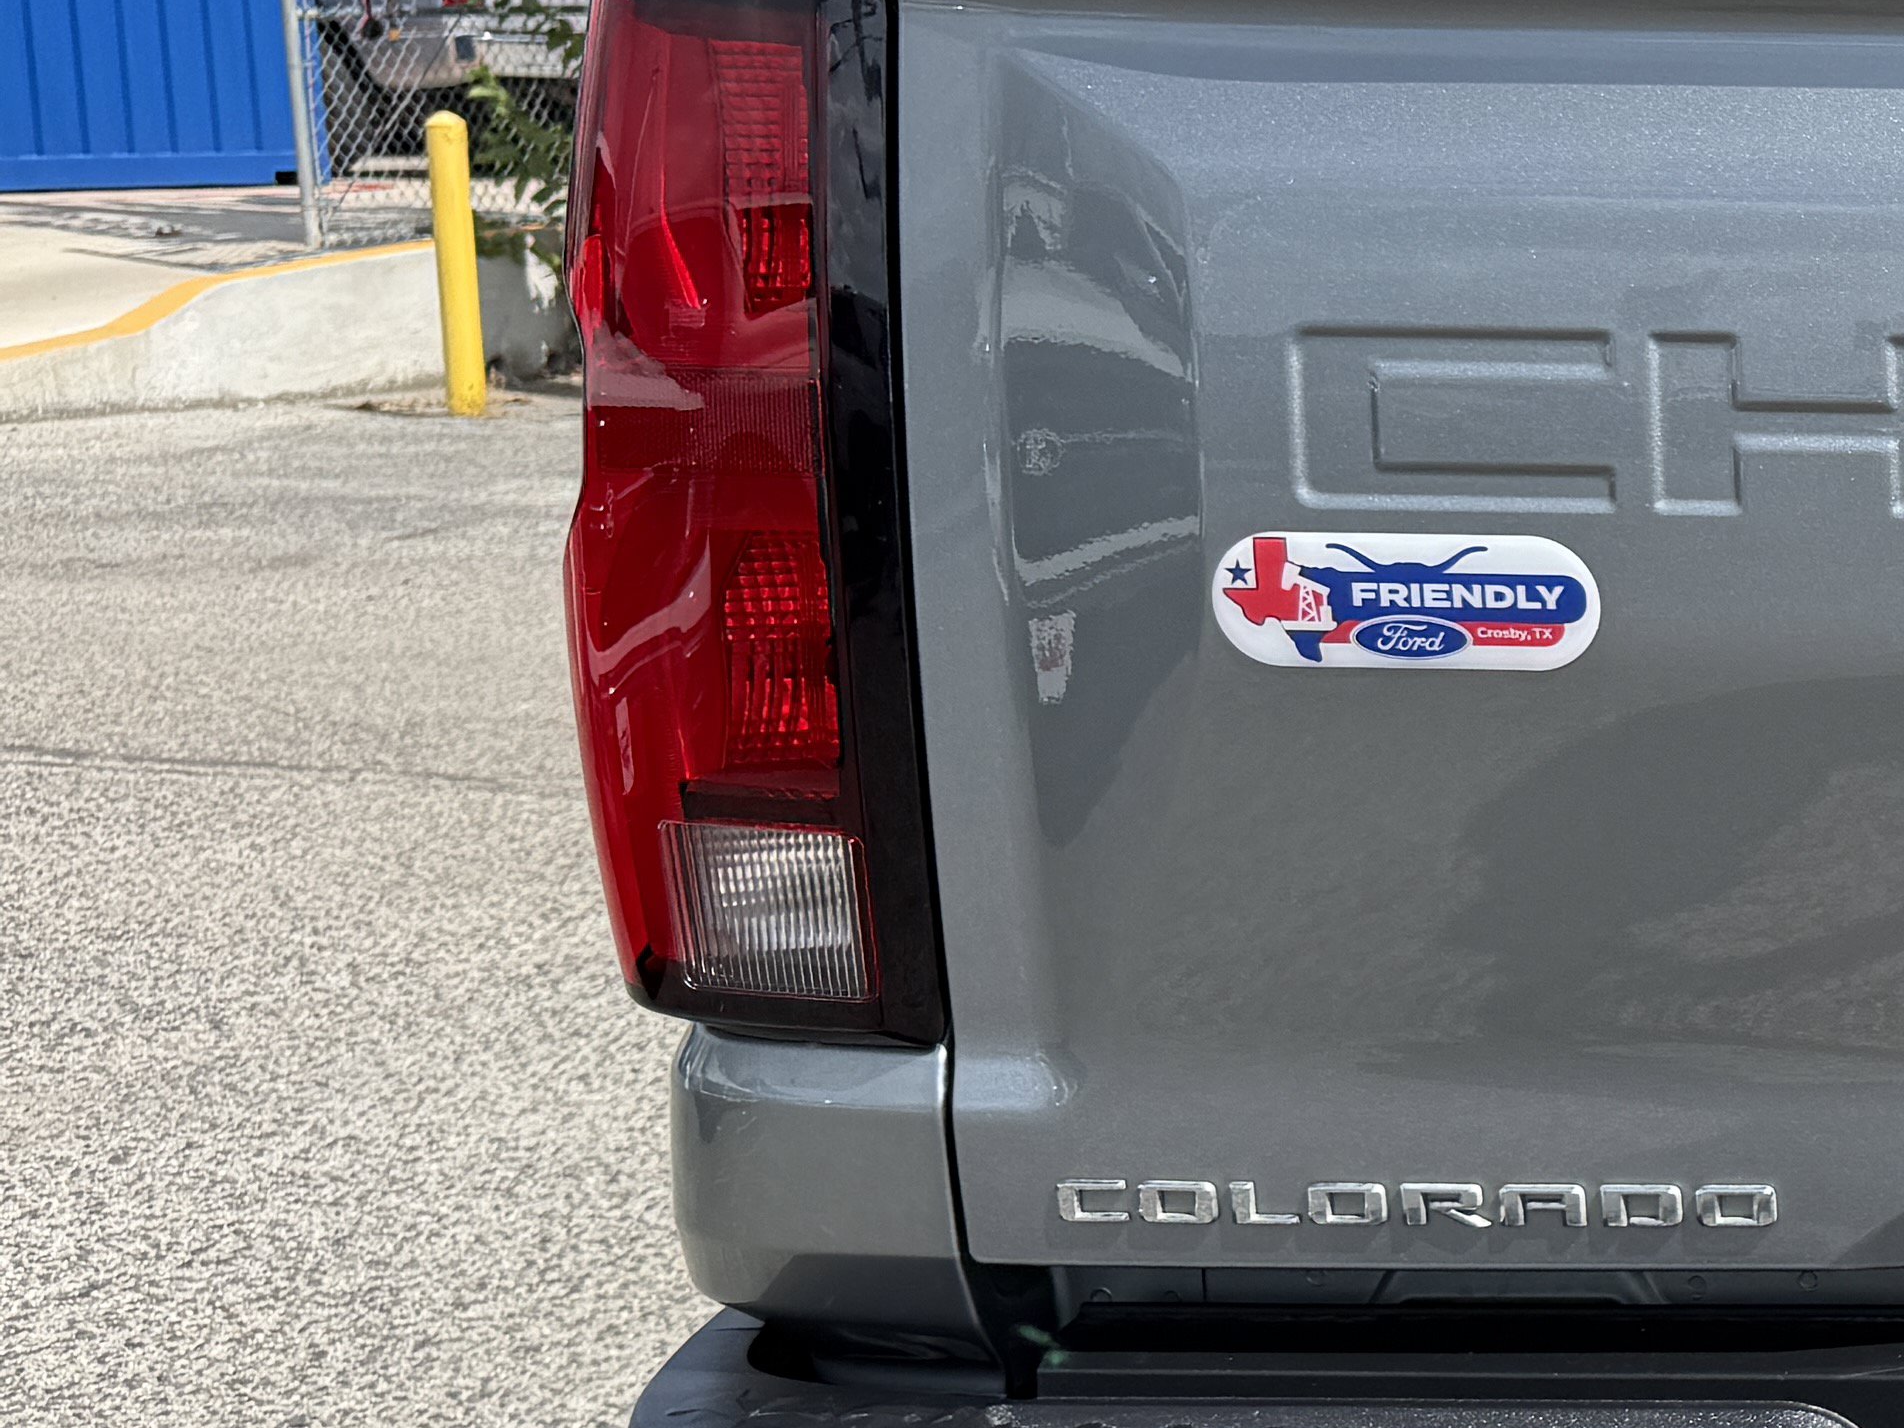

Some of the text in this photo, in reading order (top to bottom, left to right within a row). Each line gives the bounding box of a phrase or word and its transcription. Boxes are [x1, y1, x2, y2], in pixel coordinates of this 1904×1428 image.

[1351, 582, 1565, 611] FRIENDLY
[1377, 621, 1445, 652] Ford
[1477, 627, 1553, 642] Crosby, TX
[1056, 1179, 1779, 1228] COLORADO
